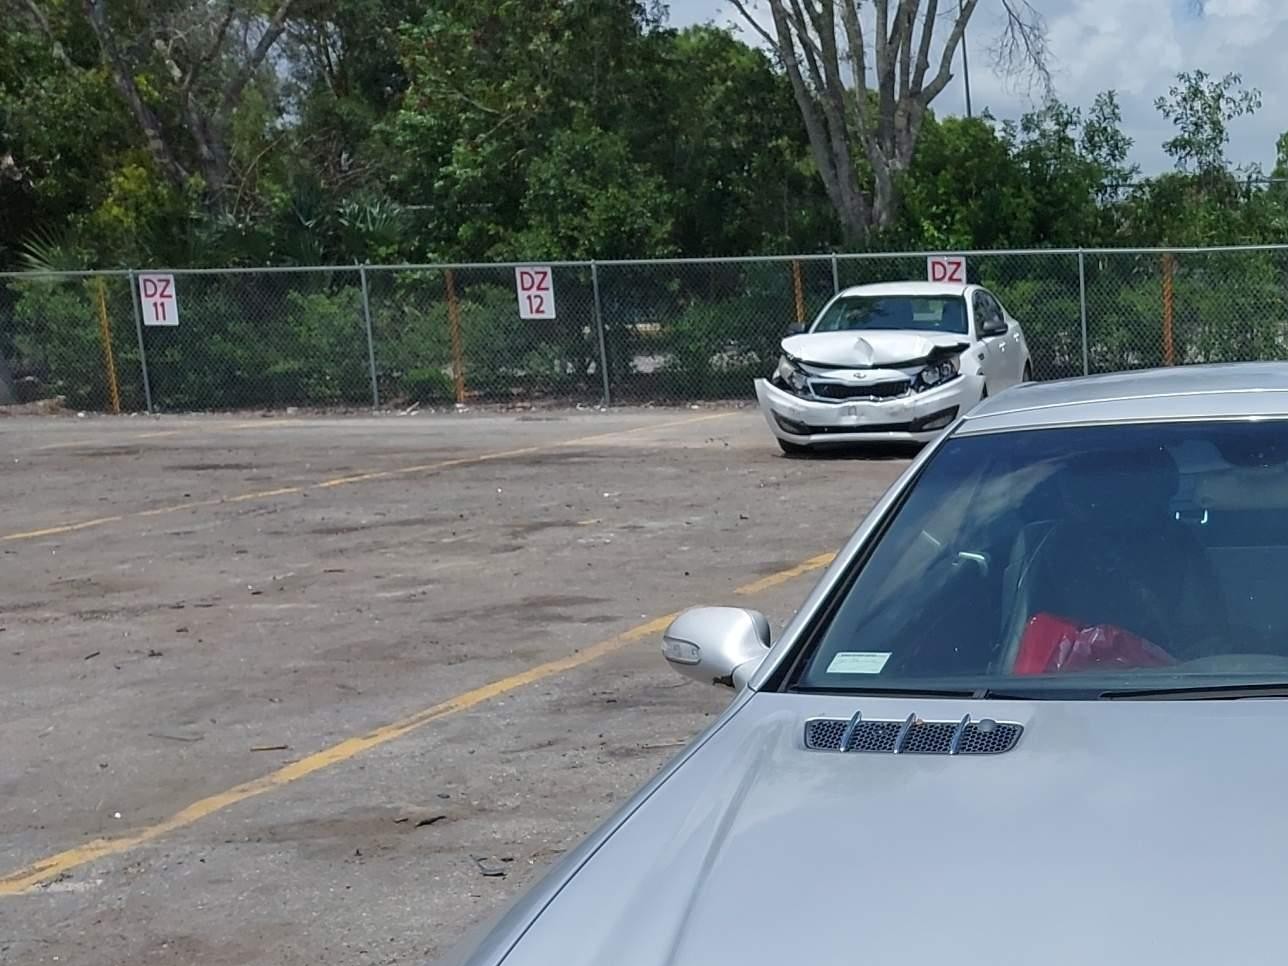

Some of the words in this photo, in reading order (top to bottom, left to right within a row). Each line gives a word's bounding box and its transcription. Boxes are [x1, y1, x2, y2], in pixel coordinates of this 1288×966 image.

[520, 271, 549, 291] DZ
[931, 261, 962, 282] DZ
[143, 279, 173, 298] DZ
[153, 302, 166, 321] 11
[527, 295, 545, 314] 12
